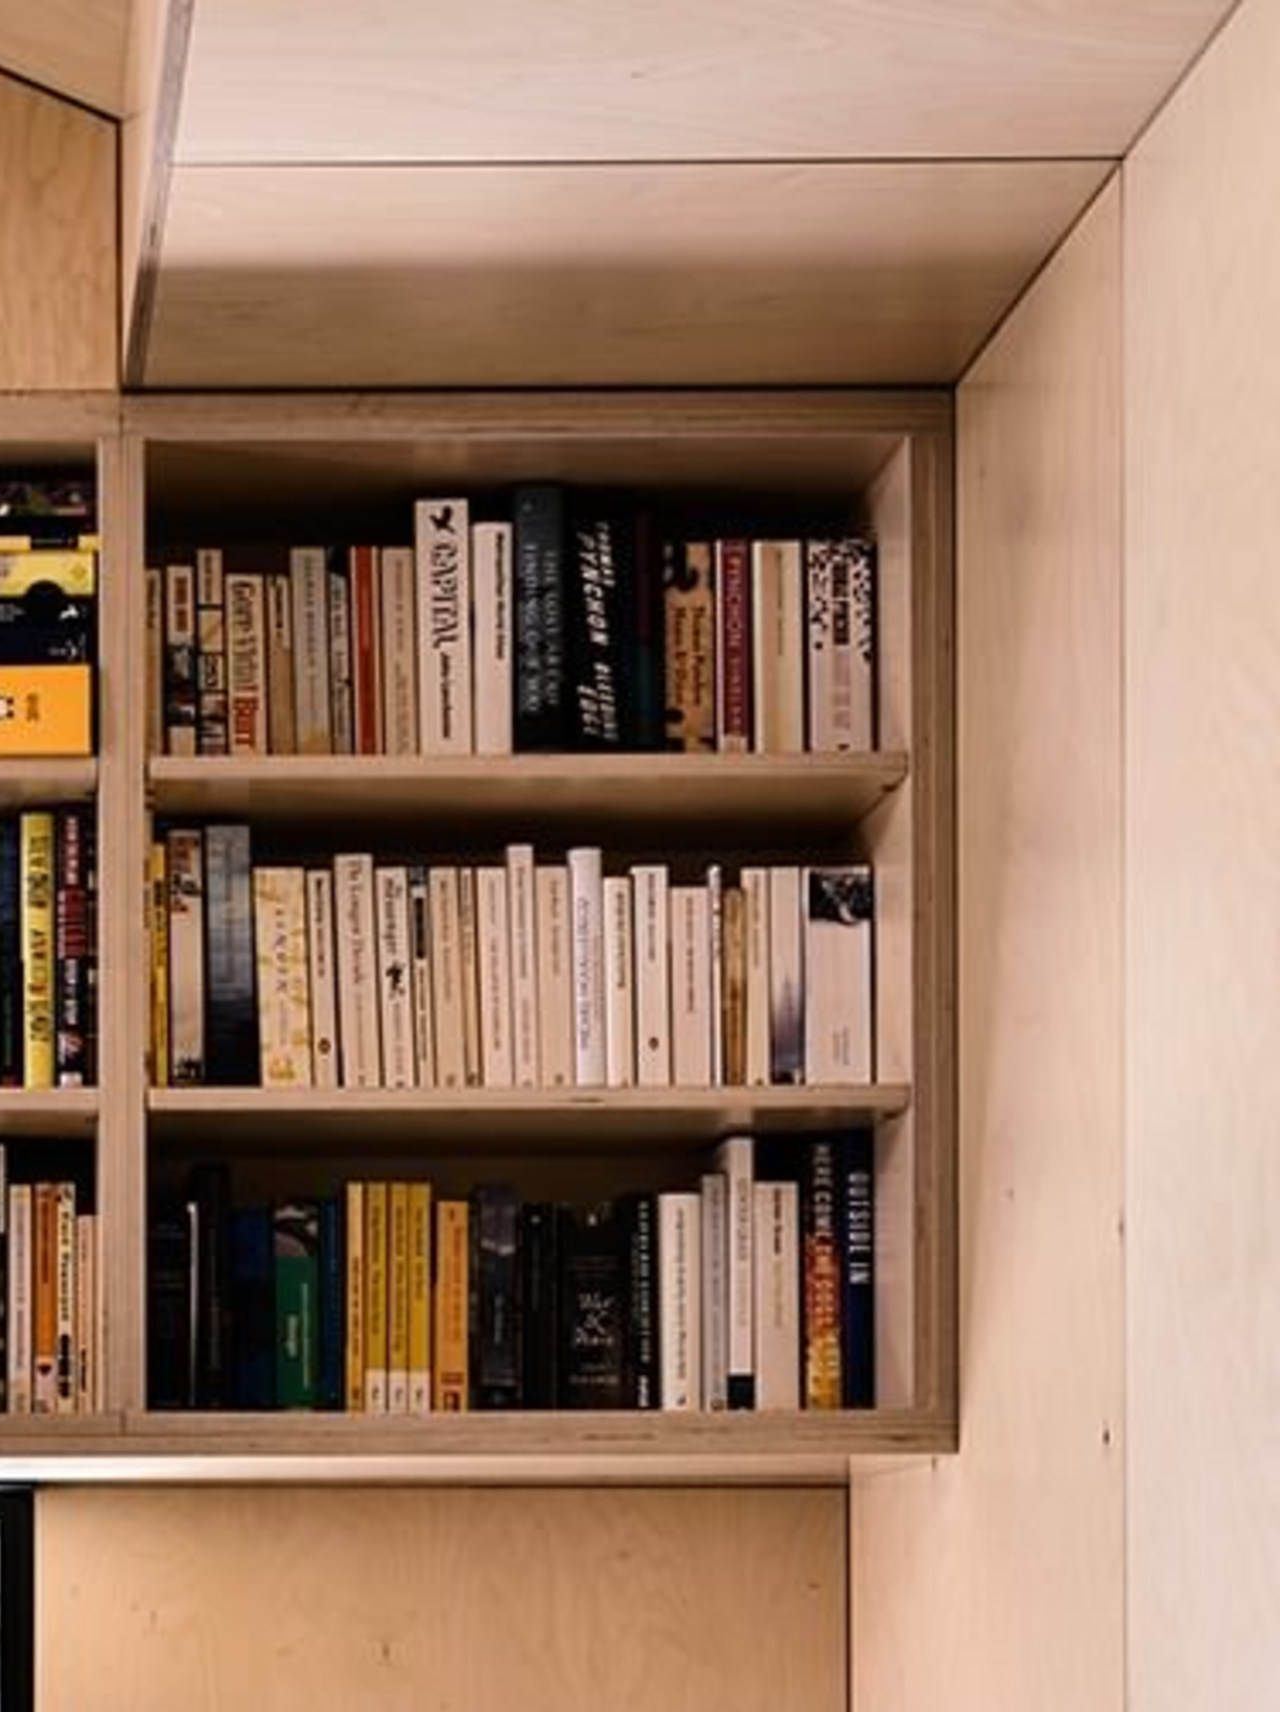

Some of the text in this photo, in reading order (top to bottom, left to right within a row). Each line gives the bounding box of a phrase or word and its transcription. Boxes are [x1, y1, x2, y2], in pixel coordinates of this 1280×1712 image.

[431, 542, 459, 649] CAPITAL
[726, 555, 742, 648] PYNCHON
[848, 1171, 870, 1286] OUTSIDE IN
